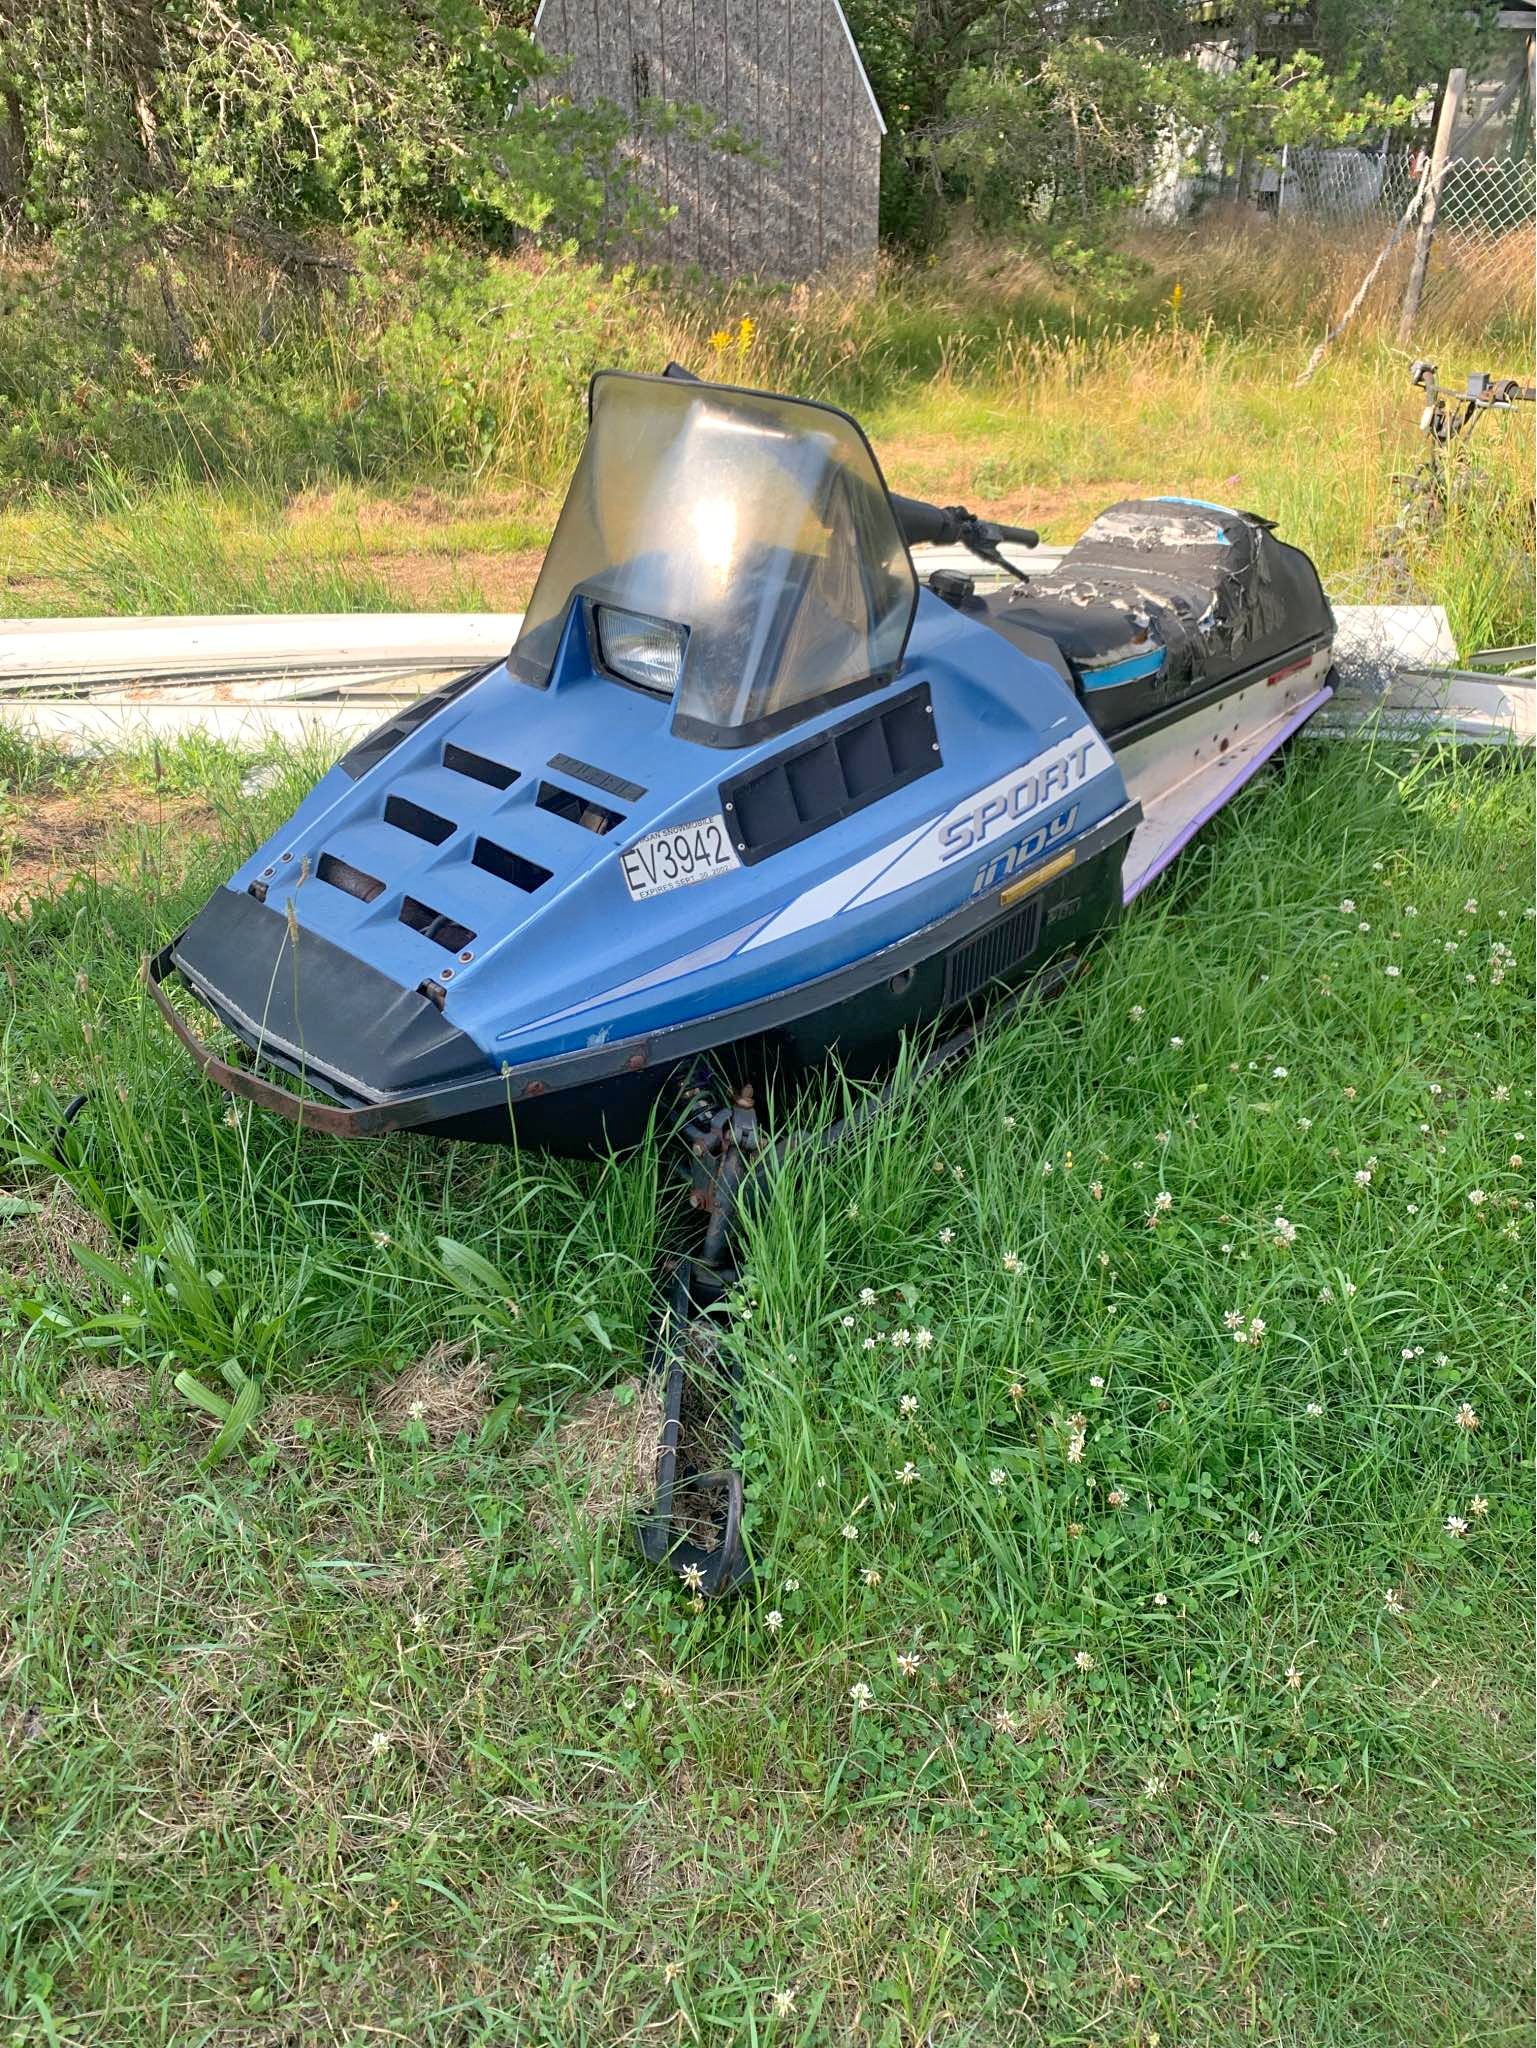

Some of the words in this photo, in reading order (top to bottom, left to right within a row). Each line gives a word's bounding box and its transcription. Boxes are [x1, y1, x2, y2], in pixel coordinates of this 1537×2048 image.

[938, 741, 1096, 863] SPORT
[621, 825, 730, 891] EV3942
[639, 883, 674, 899] EXPIRES
